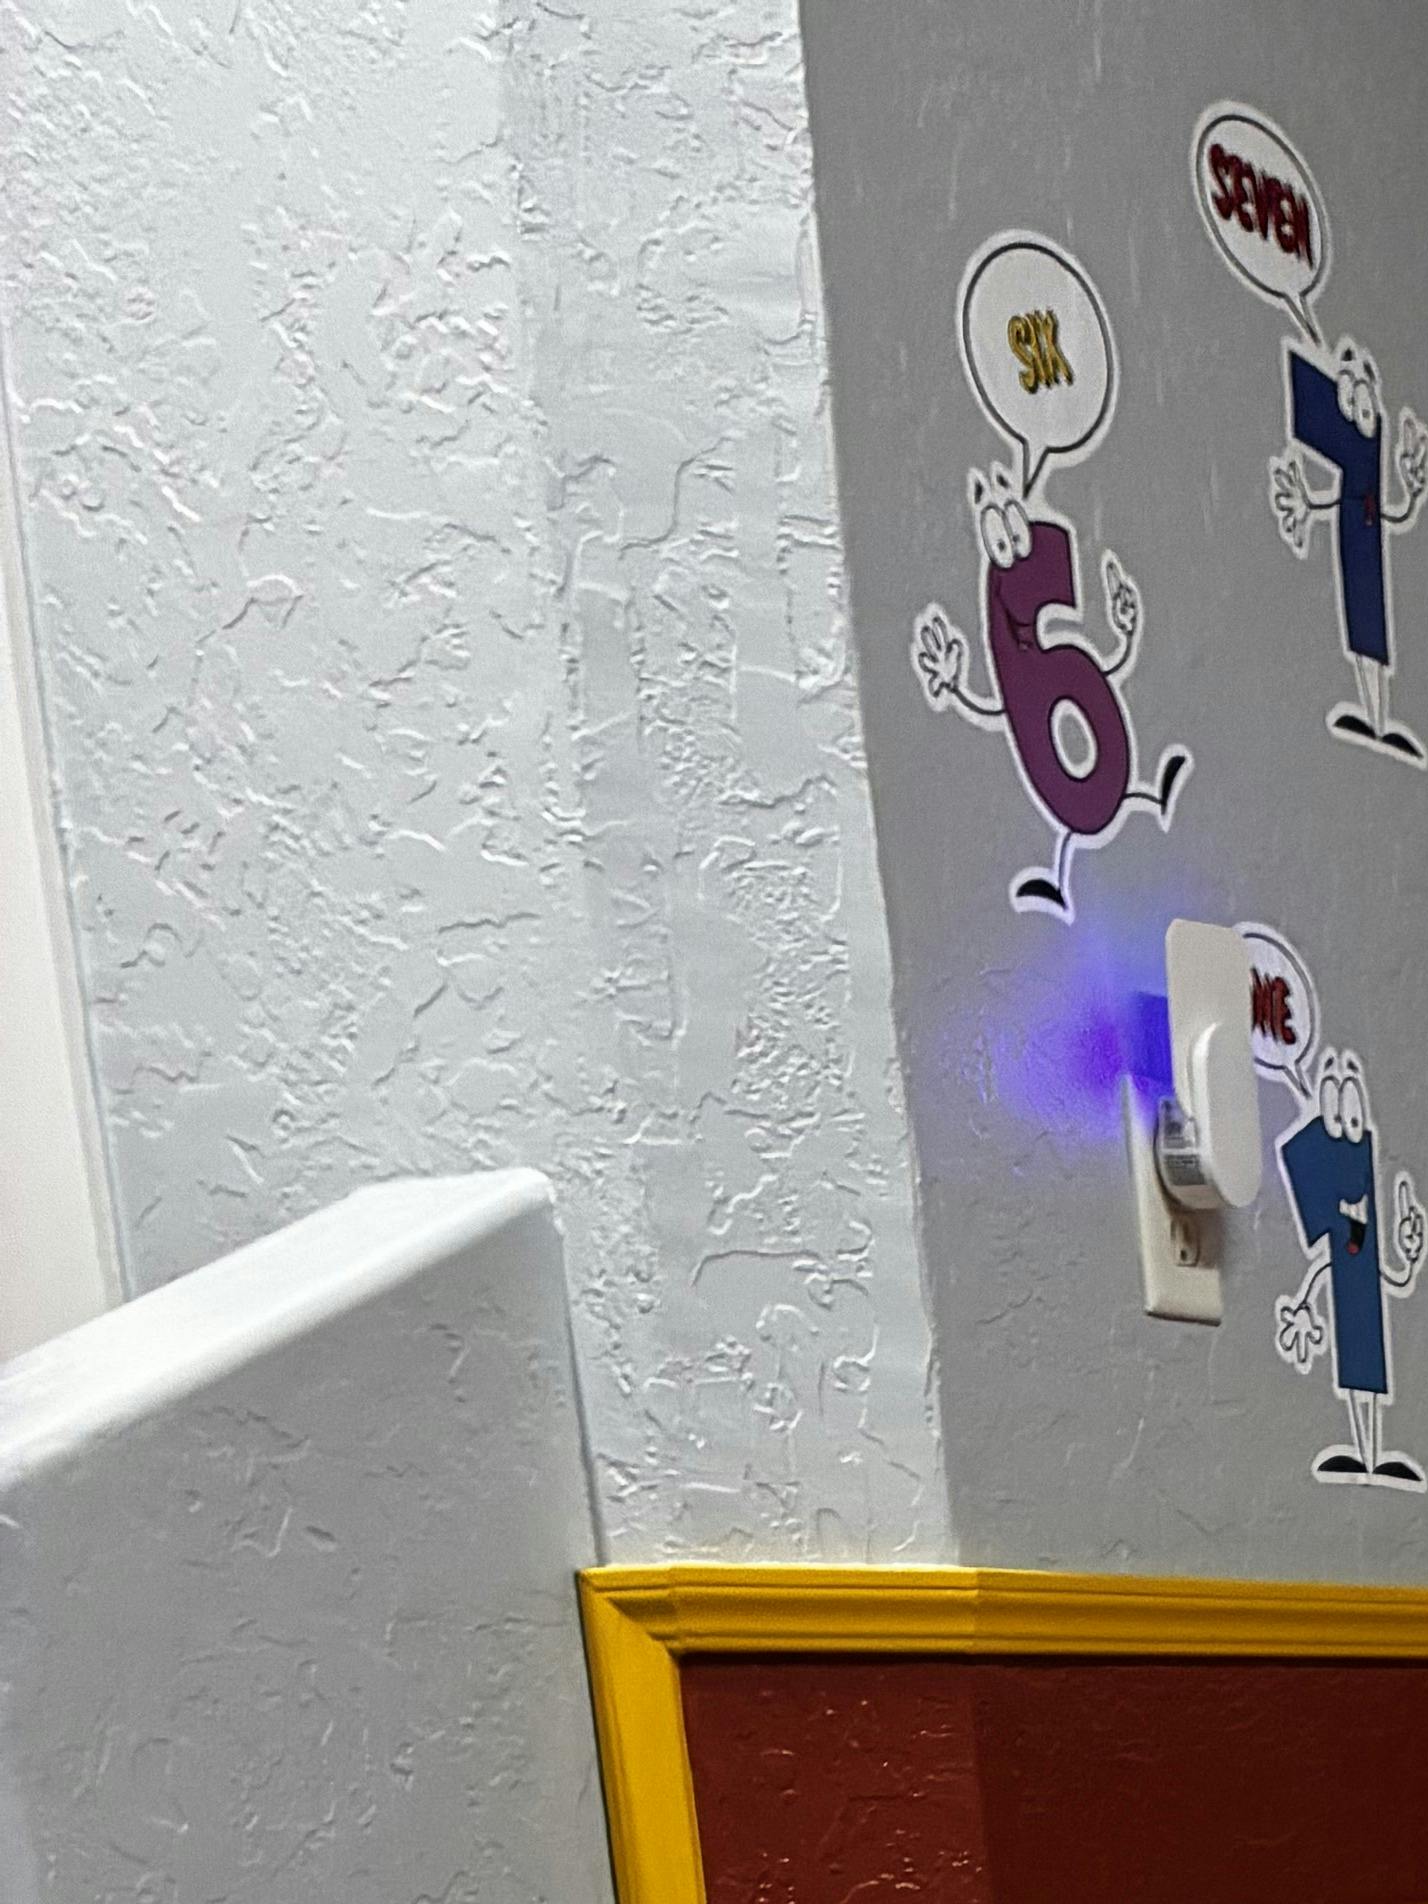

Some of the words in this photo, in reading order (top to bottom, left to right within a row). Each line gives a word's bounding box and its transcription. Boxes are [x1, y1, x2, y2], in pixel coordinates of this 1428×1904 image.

[1207, 142, 1315, 272] SEVEN
[1006, 307, 1076, 395] SIX
[1285, 346, 1393, 668] 7
[986, 518, 1131, 837] 6
[1251, 965, 1299, 1046] NE
[1280, 1110, 1389, 1396] 1
